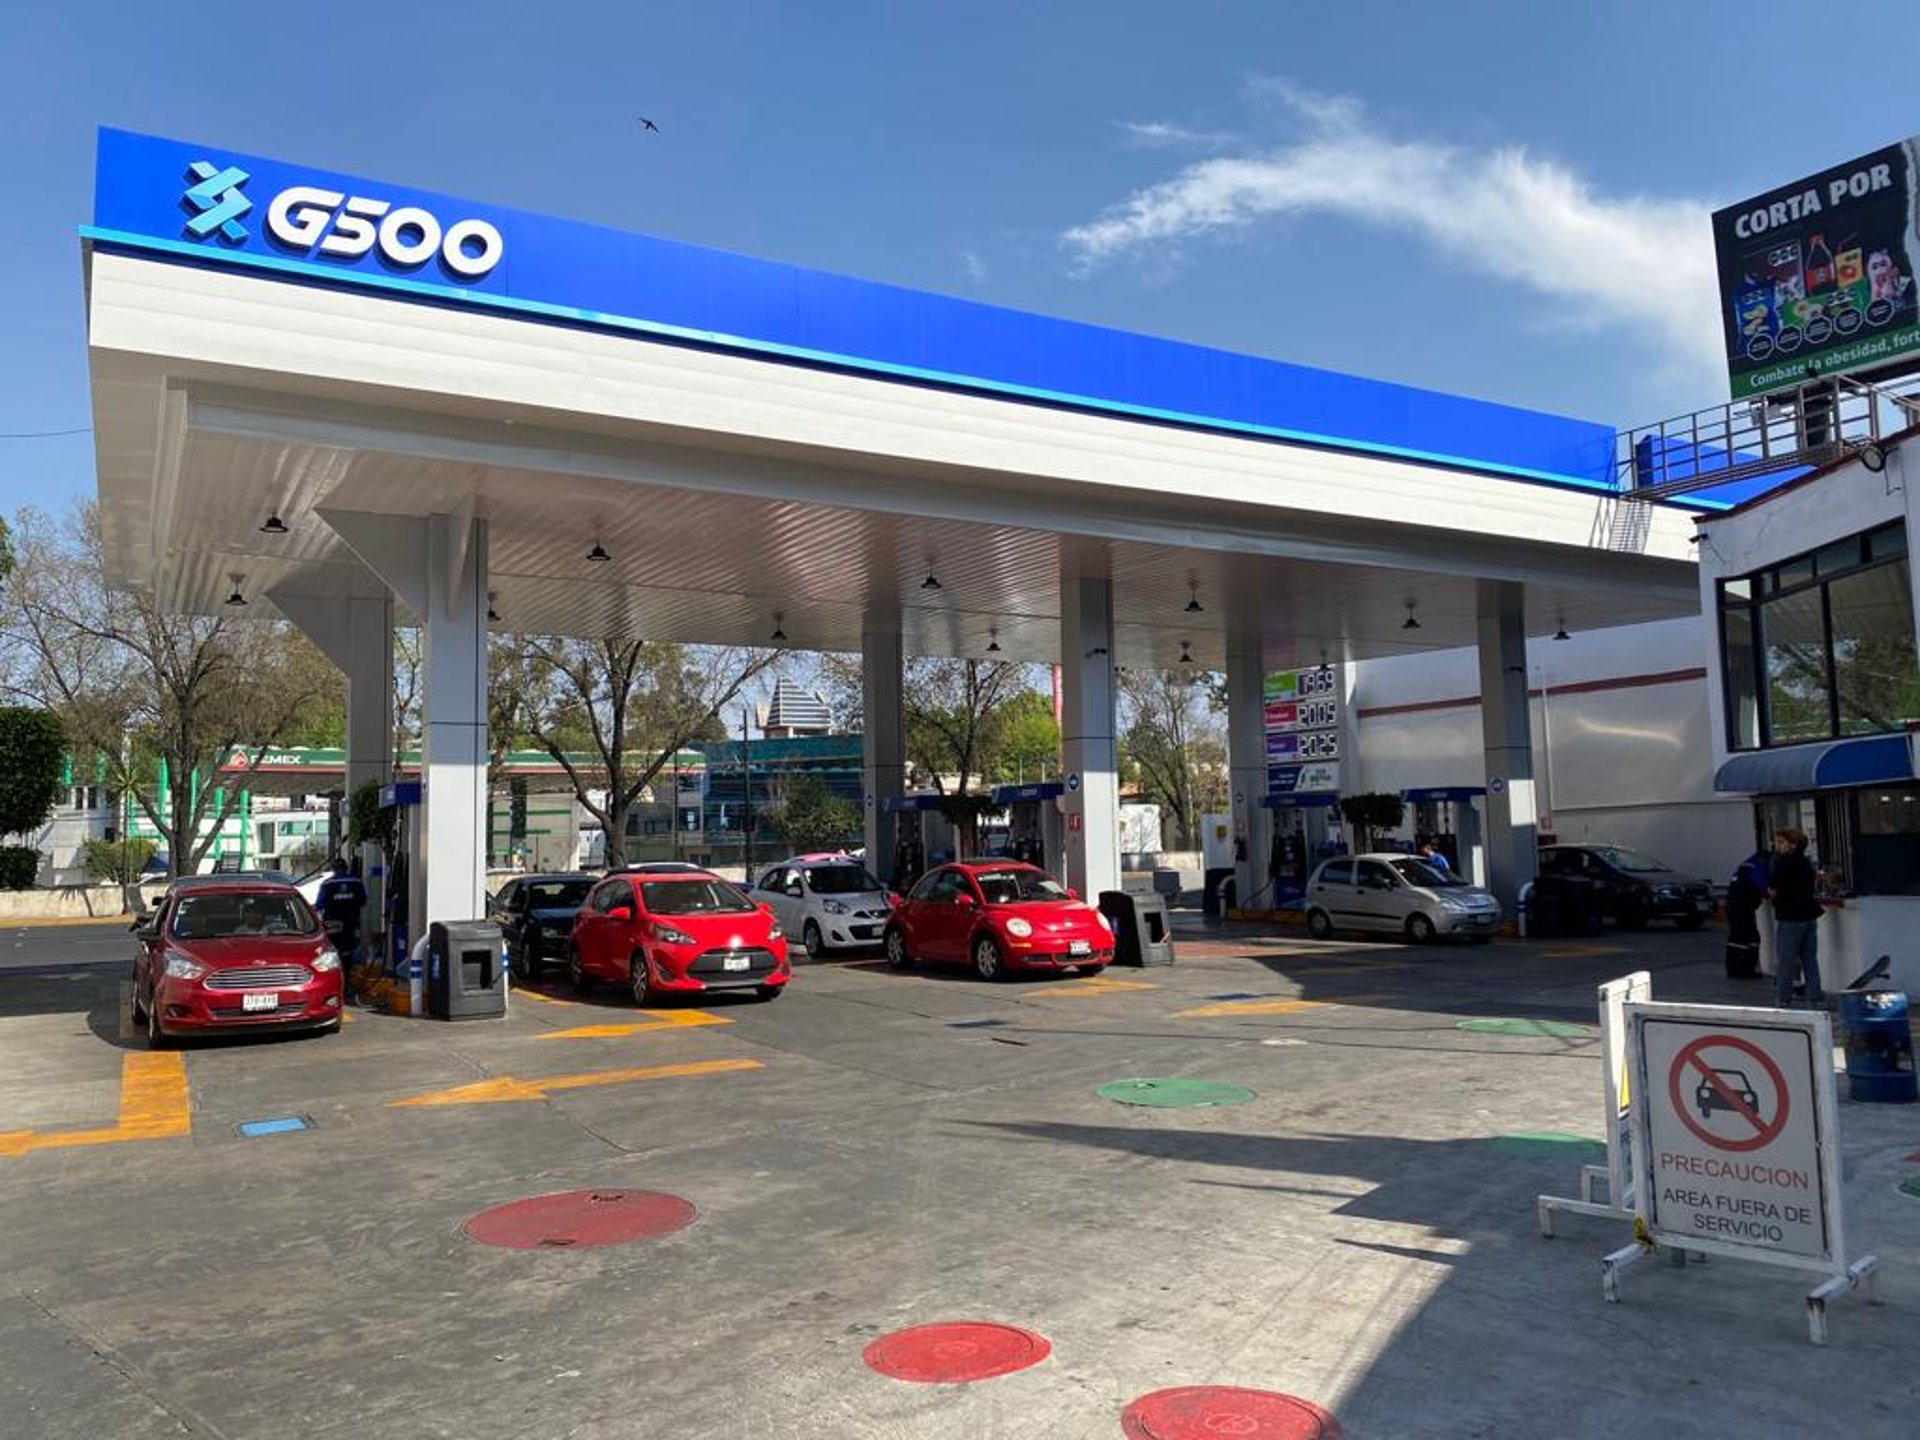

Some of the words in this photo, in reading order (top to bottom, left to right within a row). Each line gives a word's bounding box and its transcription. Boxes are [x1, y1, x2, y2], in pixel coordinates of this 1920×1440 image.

[1734, 189, 1823, 239] CORTA
[1829, 163, 1893, 207] POR
[266, 185, 504, 277] G500
[1750, 365, 1806, 387] Combate
[1825, 339, 1892, 367] obesidad,
[1660, 1152, 1809, 1189] PRECAUCION
[1663, 1187, 1713, 1209] AREA
[1716, 1194, 1780, 1219] FUERA
[1784, 1205, 1814, 1225] DE
[1694, 1212, 1783, 1243] SERVICIO
